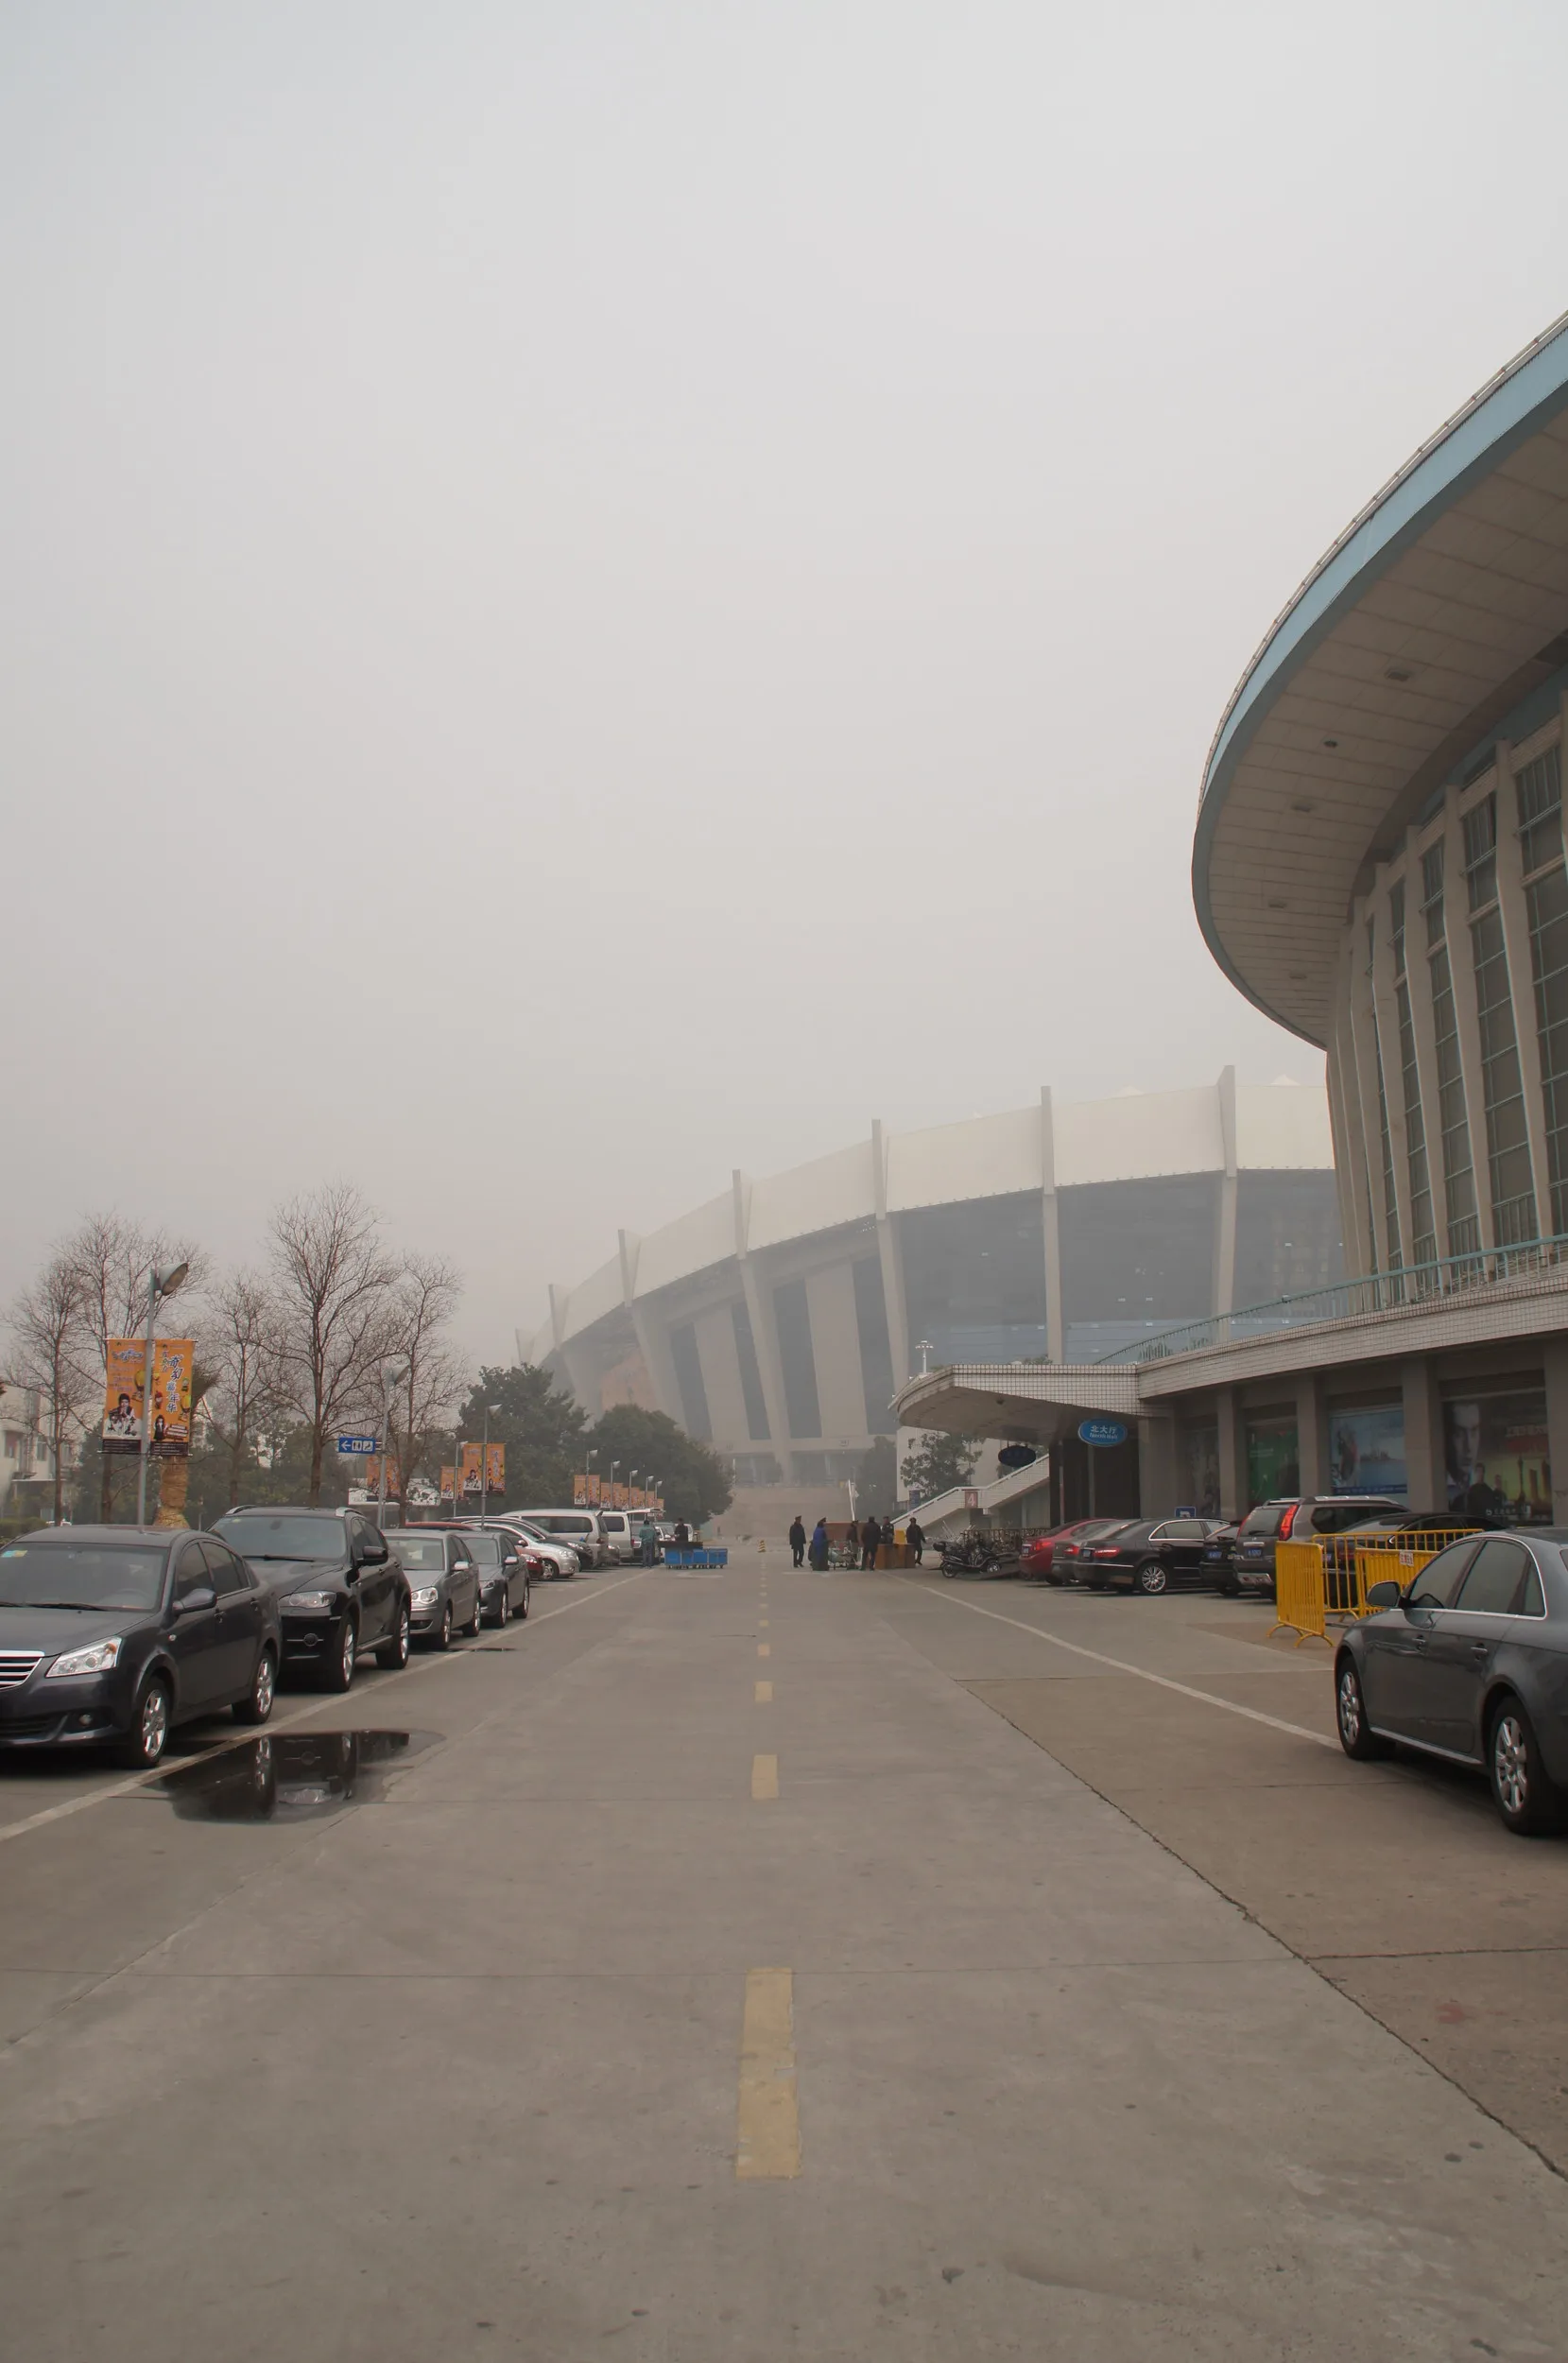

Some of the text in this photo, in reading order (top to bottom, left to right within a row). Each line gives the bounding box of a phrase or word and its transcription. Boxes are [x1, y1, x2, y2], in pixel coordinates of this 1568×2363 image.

[1090, 1425, 1116, 1434] 北大厅
[968, 1492, 975, 1507] 4
